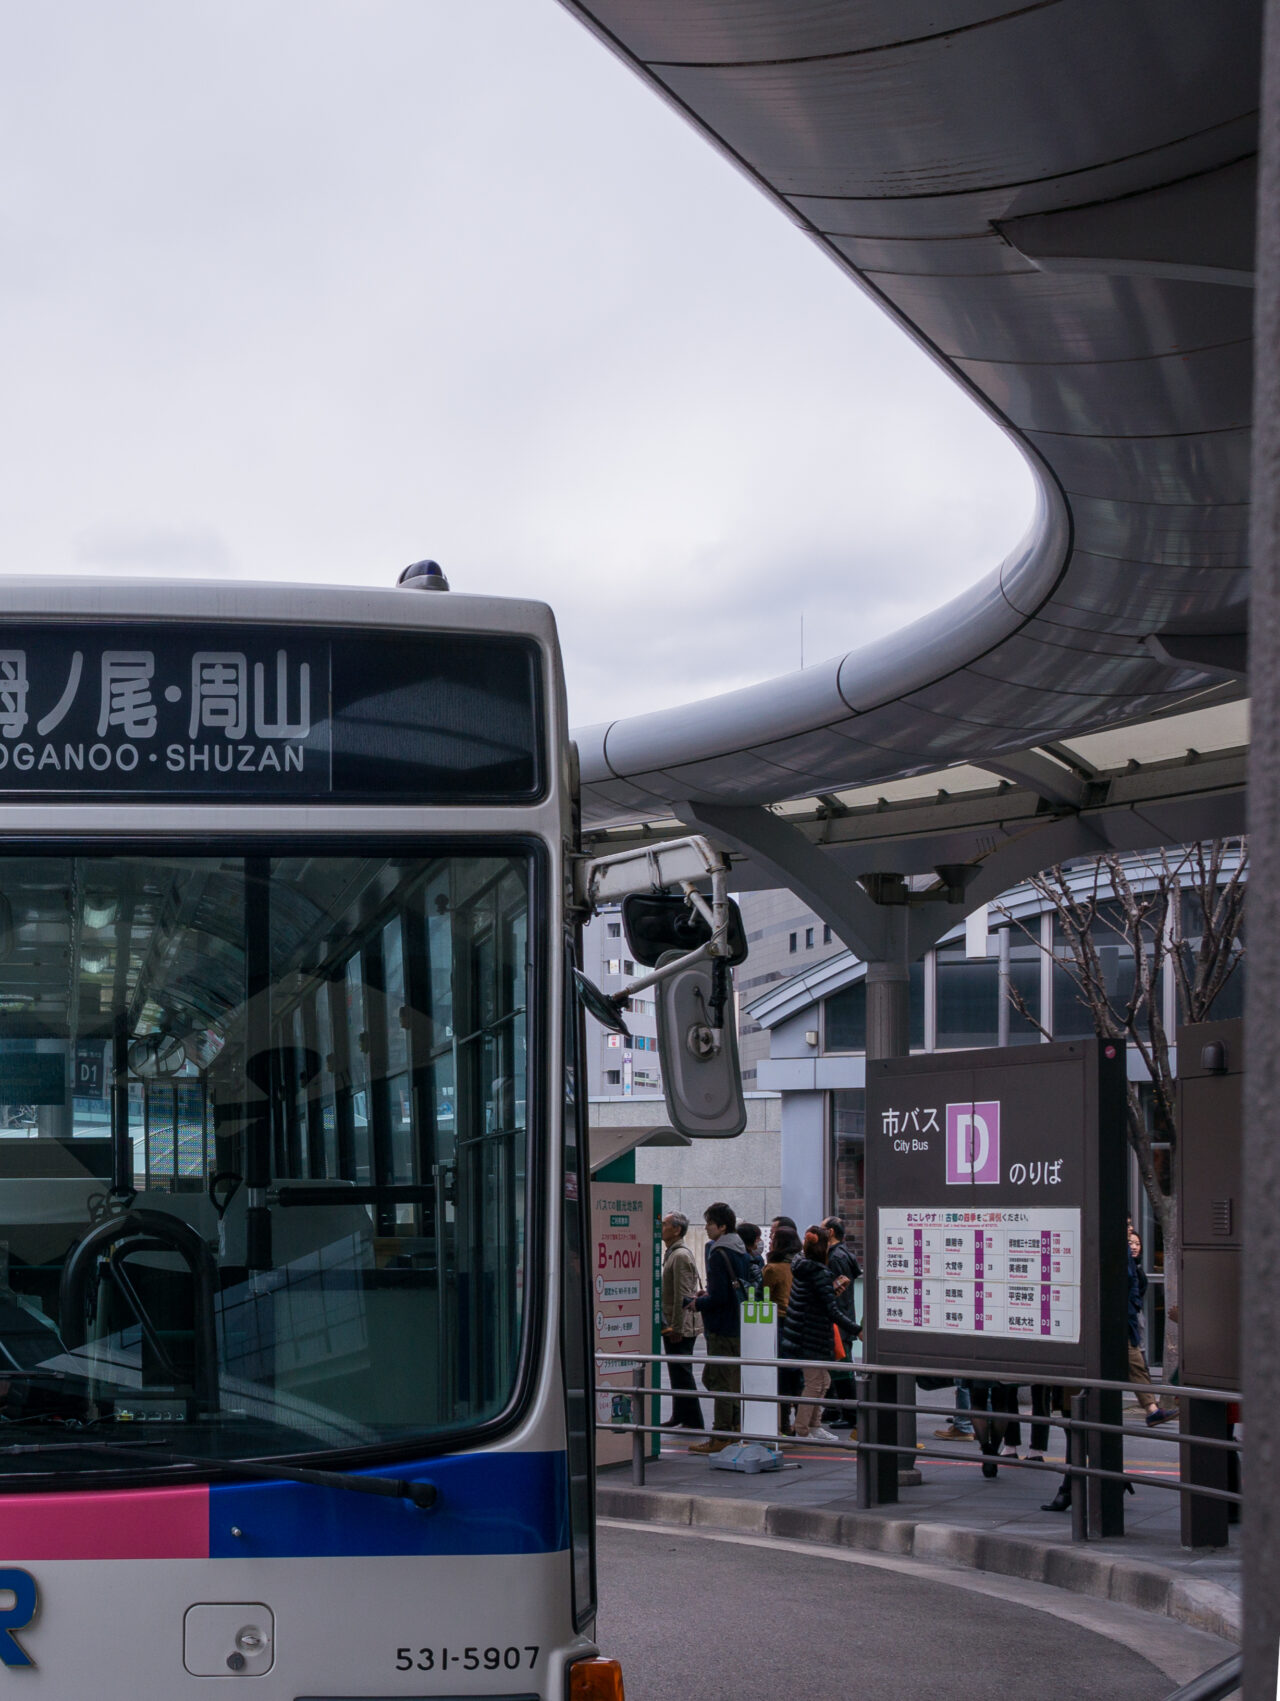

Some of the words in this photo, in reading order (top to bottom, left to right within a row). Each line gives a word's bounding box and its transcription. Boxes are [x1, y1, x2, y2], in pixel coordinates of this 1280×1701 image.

[80, 1063, 97, 1082] D1
[881, 1107, 940, 1137] 市バス
[893, 1139, 910, 1153] City
[912, 1139, 929, 1151] Bus
[956, 1113, 990, 1174] D
[1009, 1158, 1063, 1185] のりば
[394, 1645, 541, 1672] 531-5907
